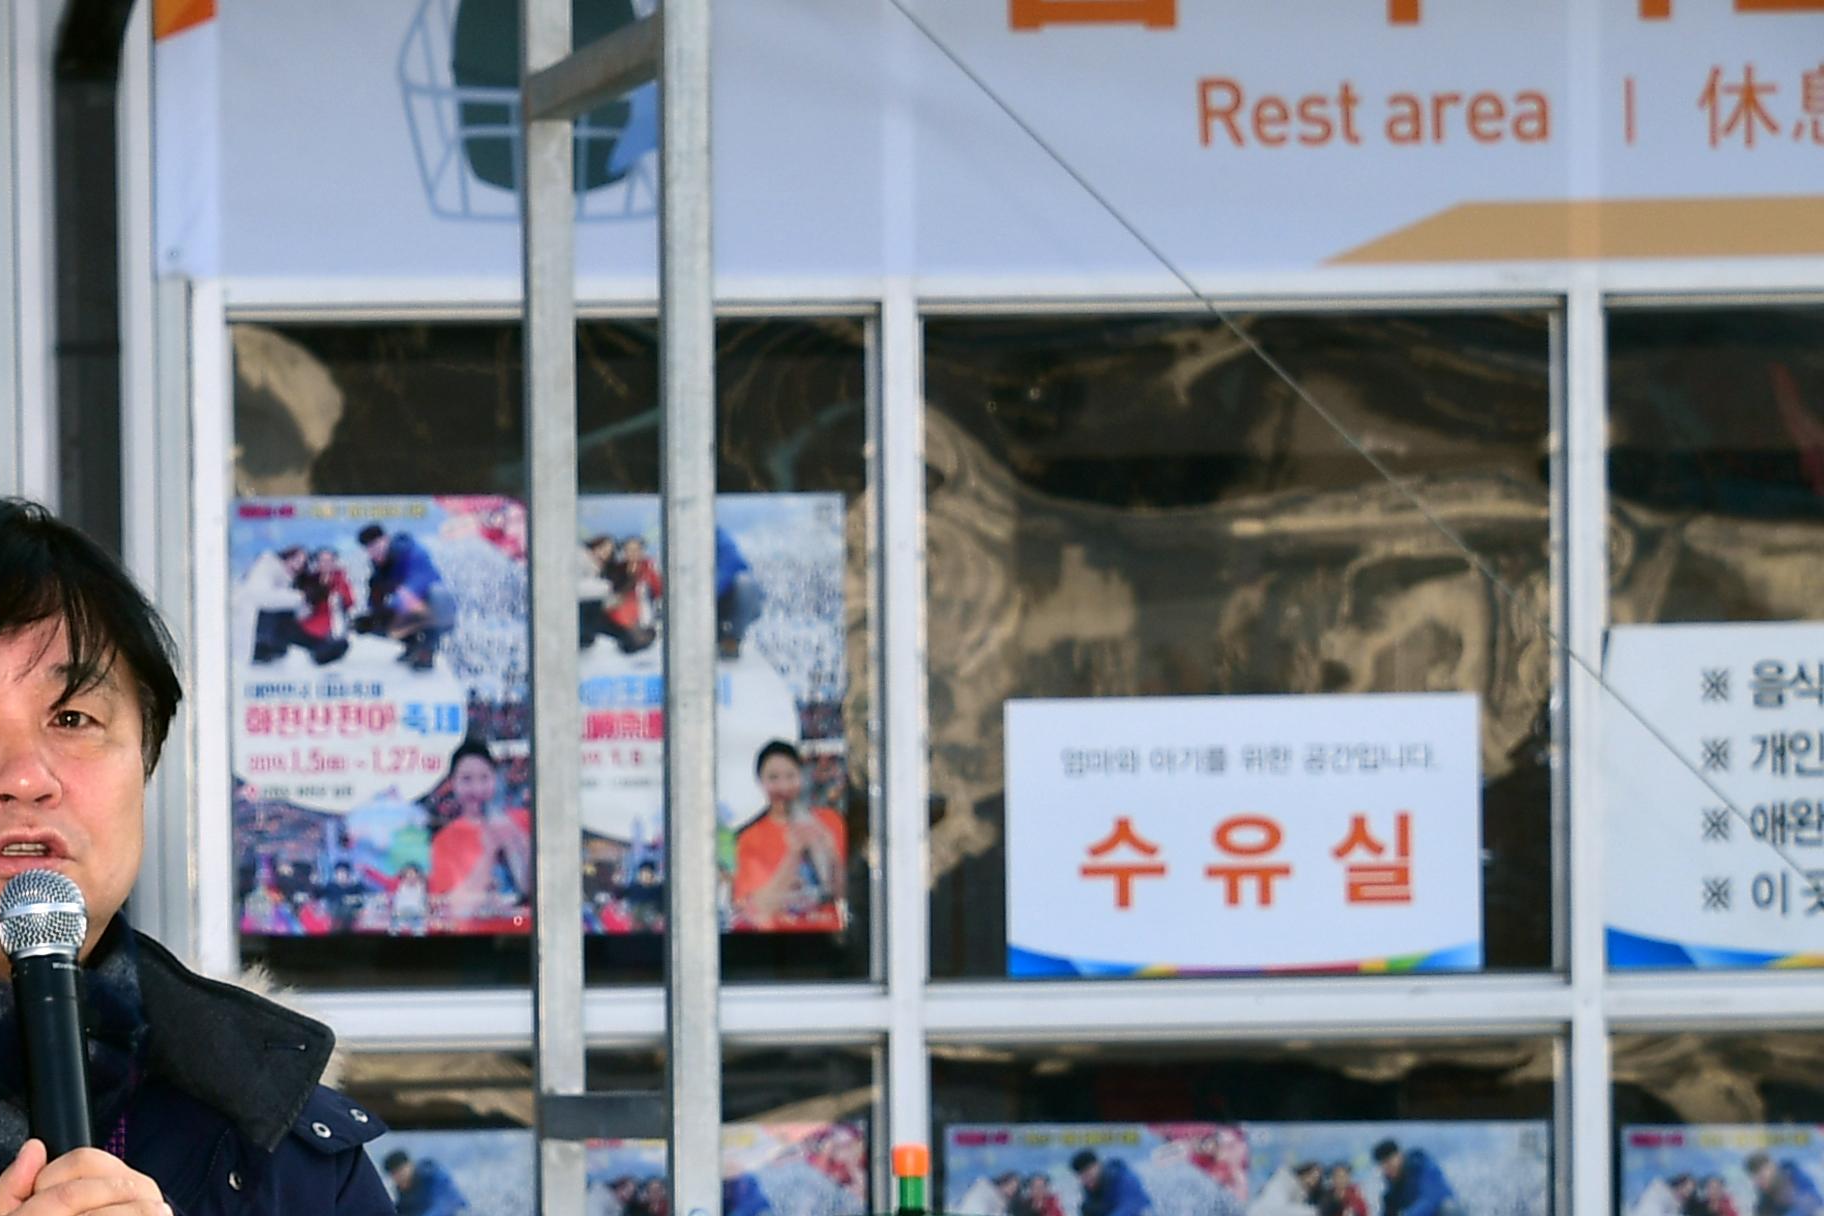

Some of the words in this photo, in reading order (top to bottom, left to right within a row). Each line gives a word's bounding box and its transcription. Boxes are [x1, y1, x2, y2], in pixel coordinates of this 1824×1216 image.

[1198, 79, 1361, 146] Rest
[1384, 90, 1550, 144] area
[1751, 872, 1789, 915] 이
